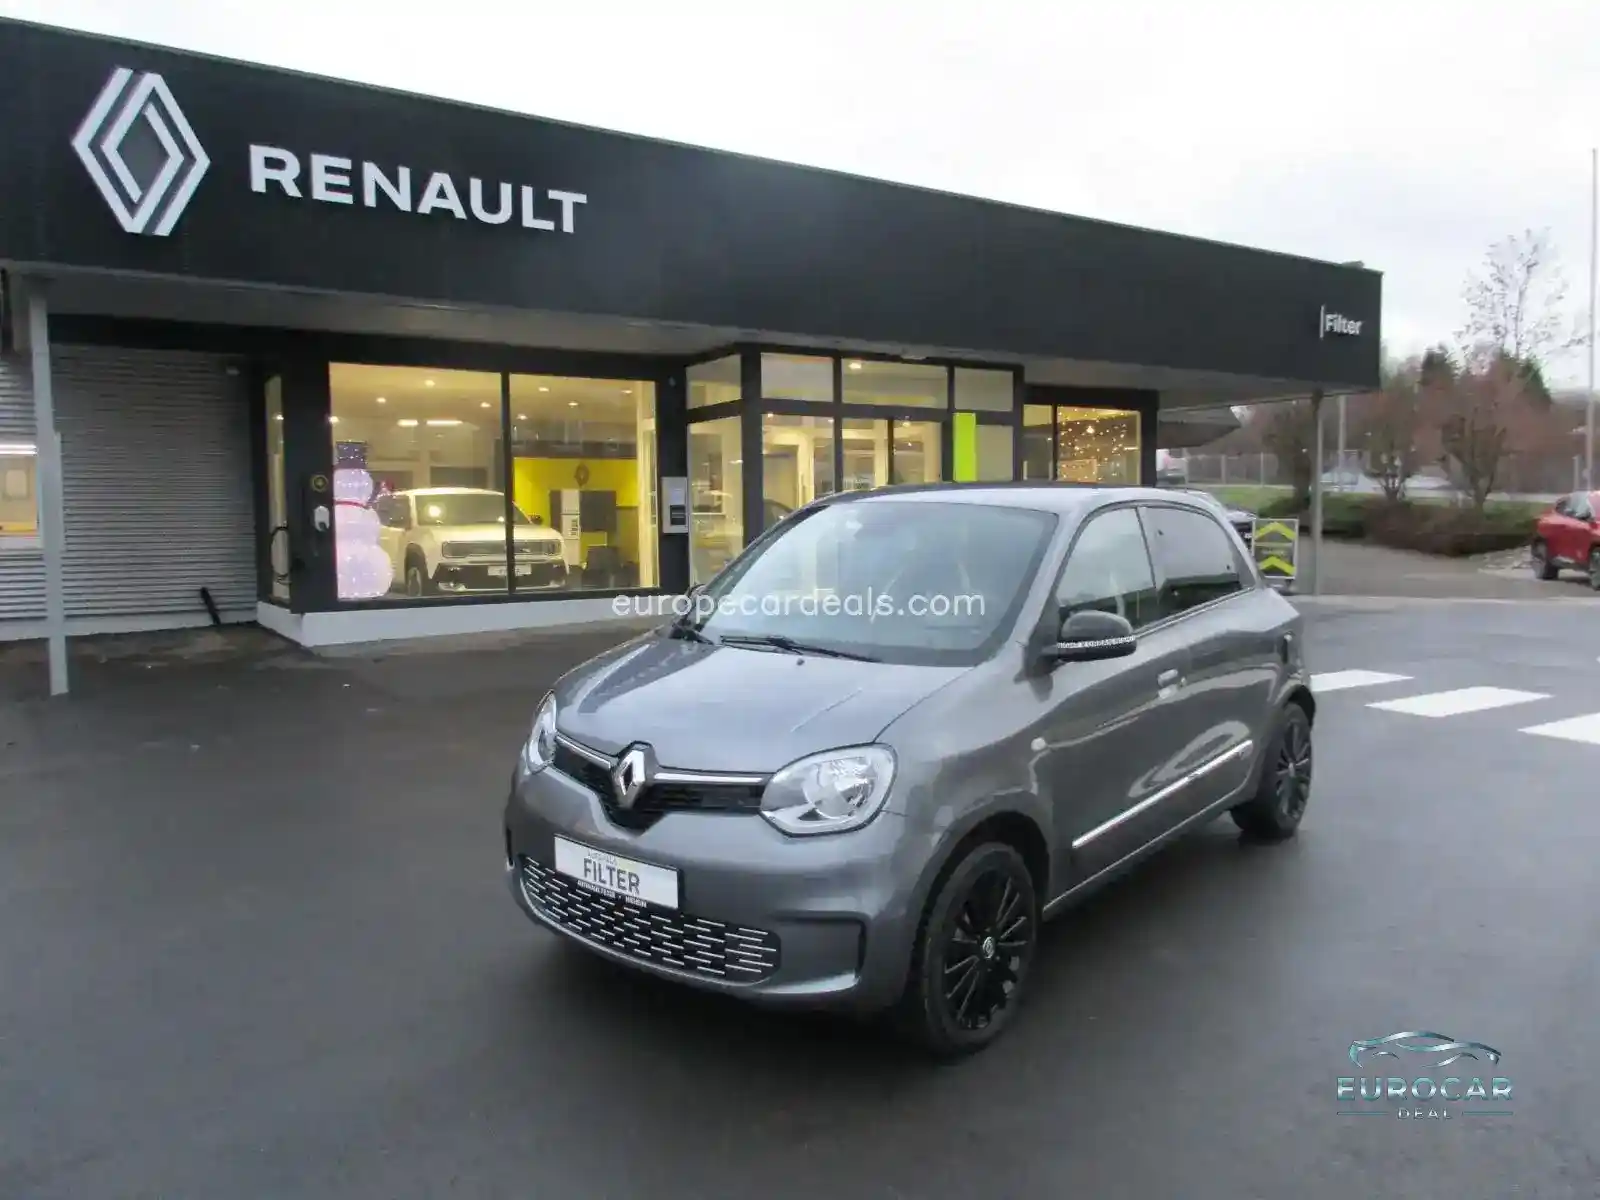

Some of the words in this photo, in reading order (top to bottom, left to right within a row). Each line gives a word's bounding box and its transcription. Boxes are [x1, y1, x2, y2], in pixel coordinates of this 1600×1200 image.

[250, 144, 587, 233] RENAULT
[1325, 313, 1363, 335] Filter
[583, 857, 640, 896] FILTER
